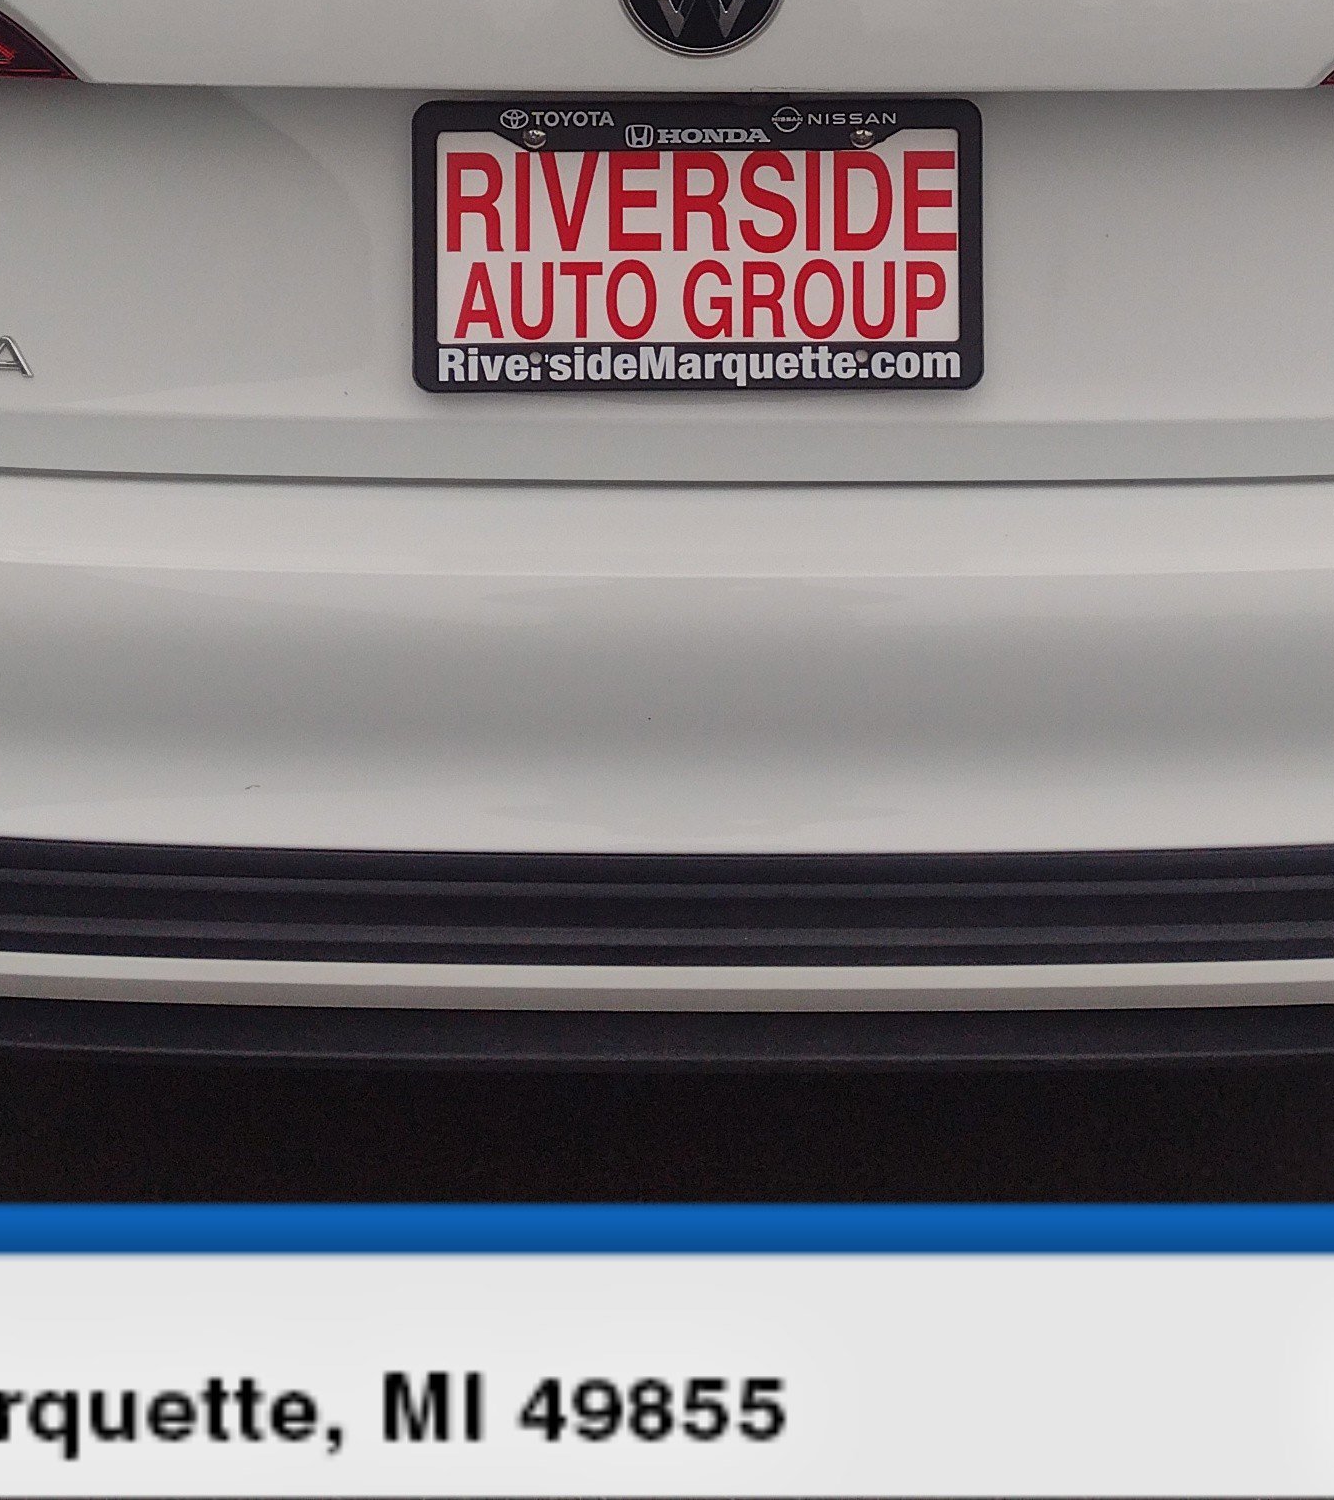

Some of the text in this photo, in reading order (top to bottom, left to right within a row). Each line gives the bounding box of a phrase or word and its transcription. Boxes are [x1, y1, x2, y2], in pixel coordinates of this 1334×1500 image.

[531, 111, 615, 127] TOYOTA
[807, 112, 897, 125] NISSAN
[657, 128, 771, 144] HONDA
[446, 151, 958, 254] RIVERSIDE
[454, 260, 948, 341] AUTO GROUP
